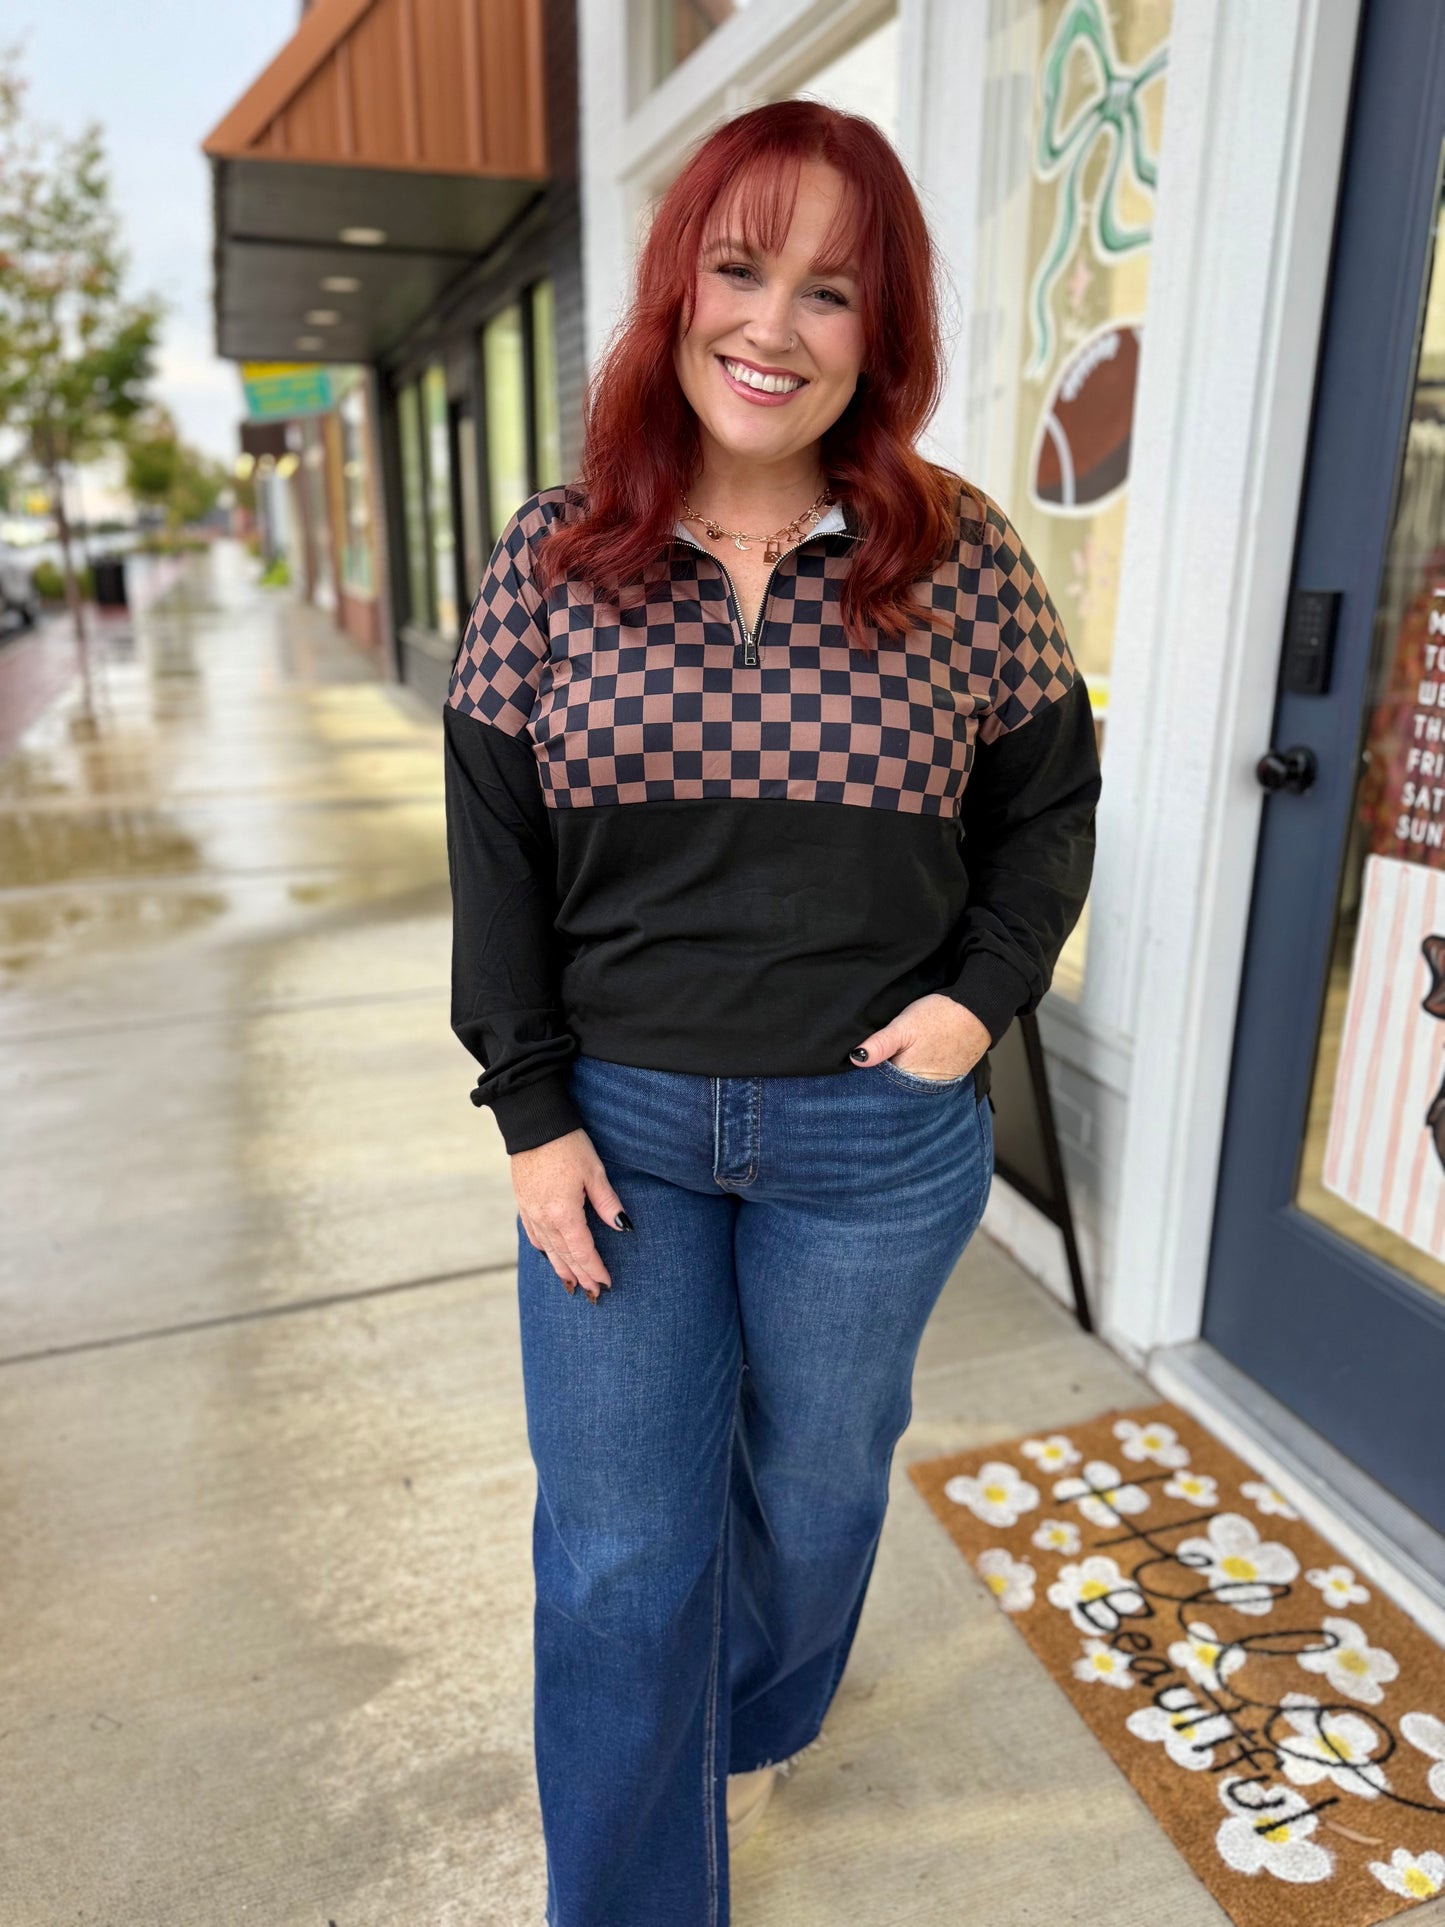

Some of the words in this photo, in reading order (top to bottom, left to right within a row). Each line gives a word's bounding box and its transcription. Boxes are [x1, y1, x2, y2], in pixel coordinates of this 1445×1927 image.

[1413, 713, 1445, 742] TH
[1406, 747, 1444, 778] FRI
[1402, 782, 1445, 813] SAT
[1395, 814, 1445, 847] SUN
[1055, 1473, 1445, 1815] Hello
[1077, 1587, 1339, 1835] Beautiful
